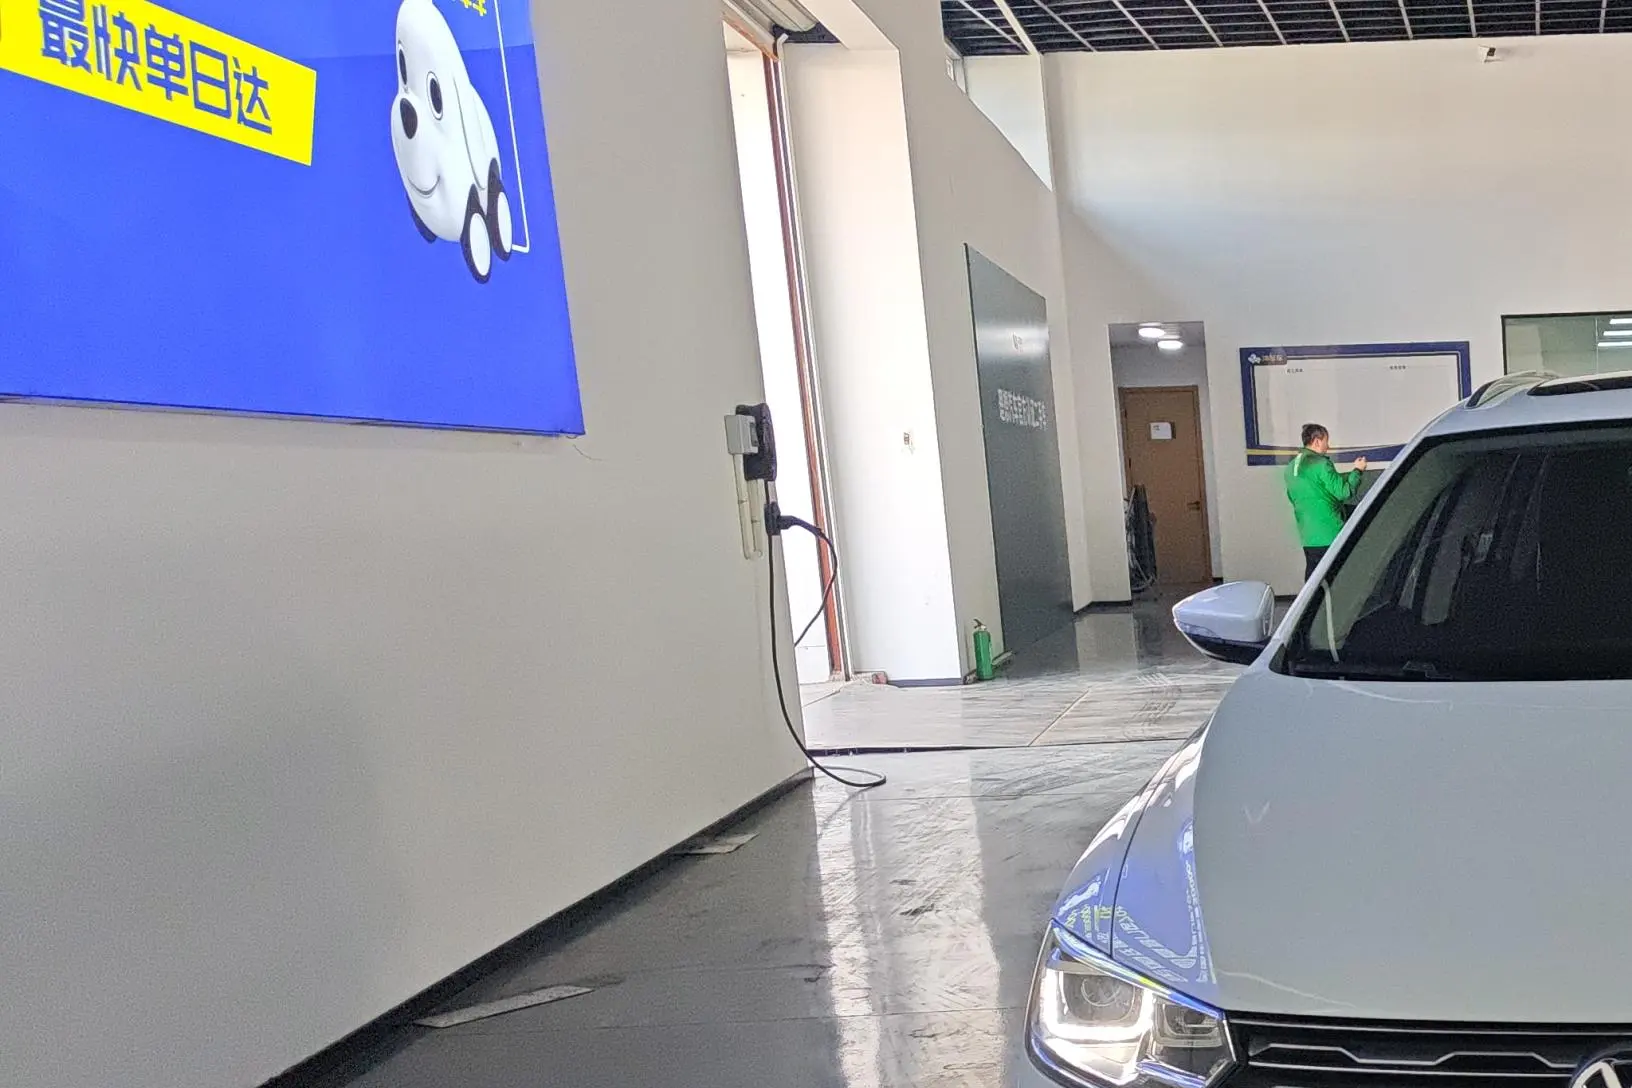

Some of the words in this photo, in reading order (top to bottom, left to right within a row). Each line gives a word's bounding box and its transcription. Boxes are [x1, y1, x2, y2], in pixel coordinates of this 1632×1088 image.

[38, 0, 273, 136] 最快单日达
